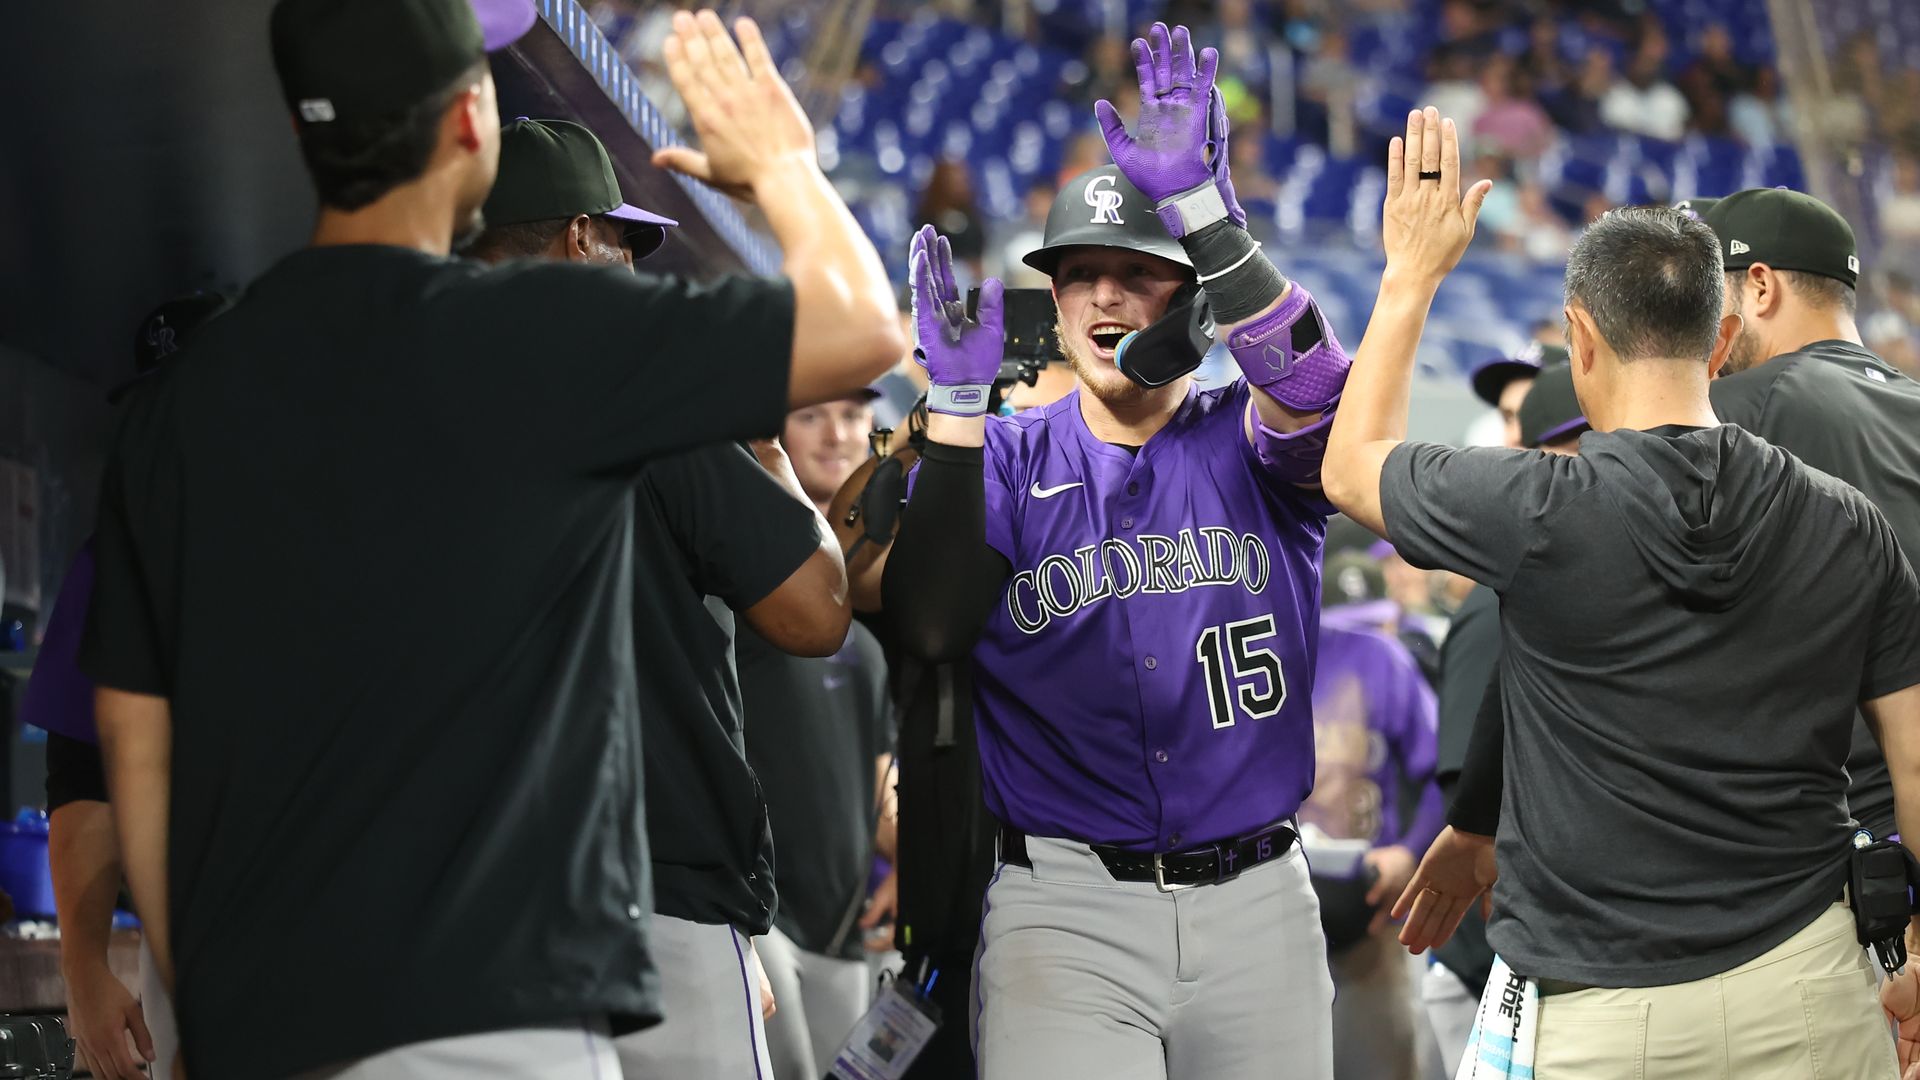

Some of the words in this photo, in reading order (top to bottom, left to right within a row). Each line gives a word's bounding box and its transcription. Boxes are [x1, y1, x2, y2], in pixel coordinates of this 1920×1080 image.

[1084, 175, 1125, 225] CR
[1007, 527, 1270, 635] COLORADO
[1196, 613, 1288, 730] 15
[1256, 836, 1272, 861] 15
